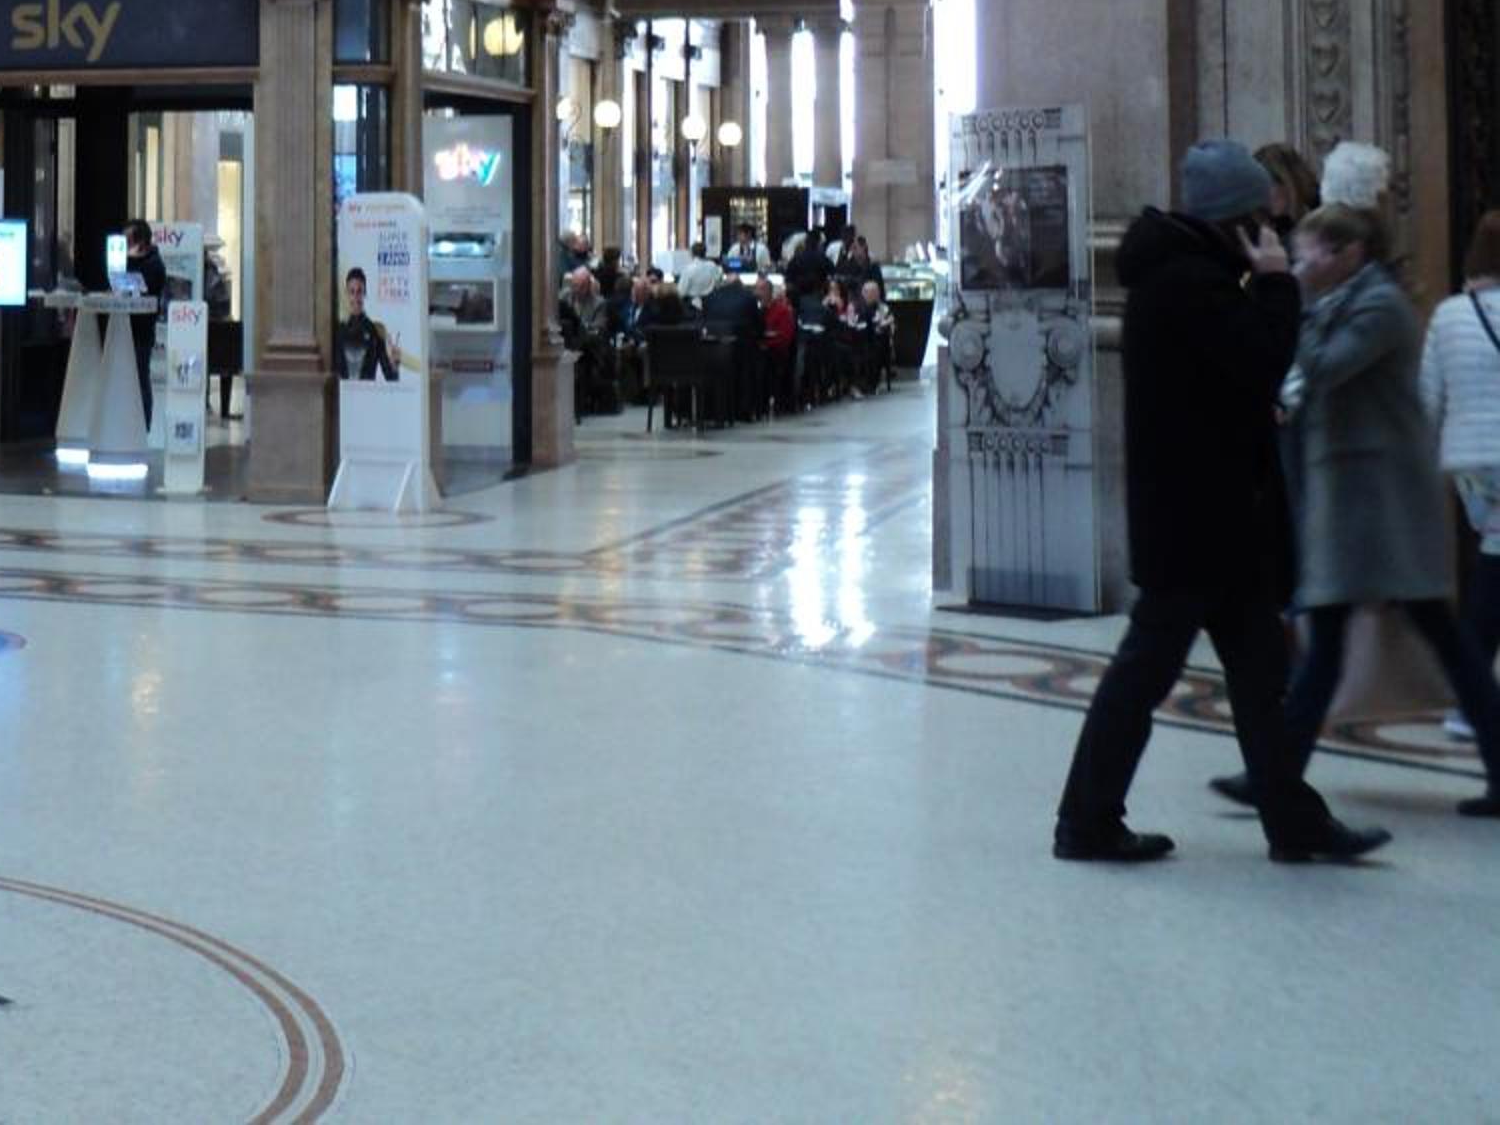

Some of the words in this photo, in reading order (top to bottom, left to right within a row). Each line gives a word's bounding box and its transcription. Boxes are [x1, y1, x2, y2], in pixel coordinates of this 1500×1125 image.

[434, 142, 501, 187] sky
[153, 226, 184, 248] sky
[171, 305, 202, 324] sky
